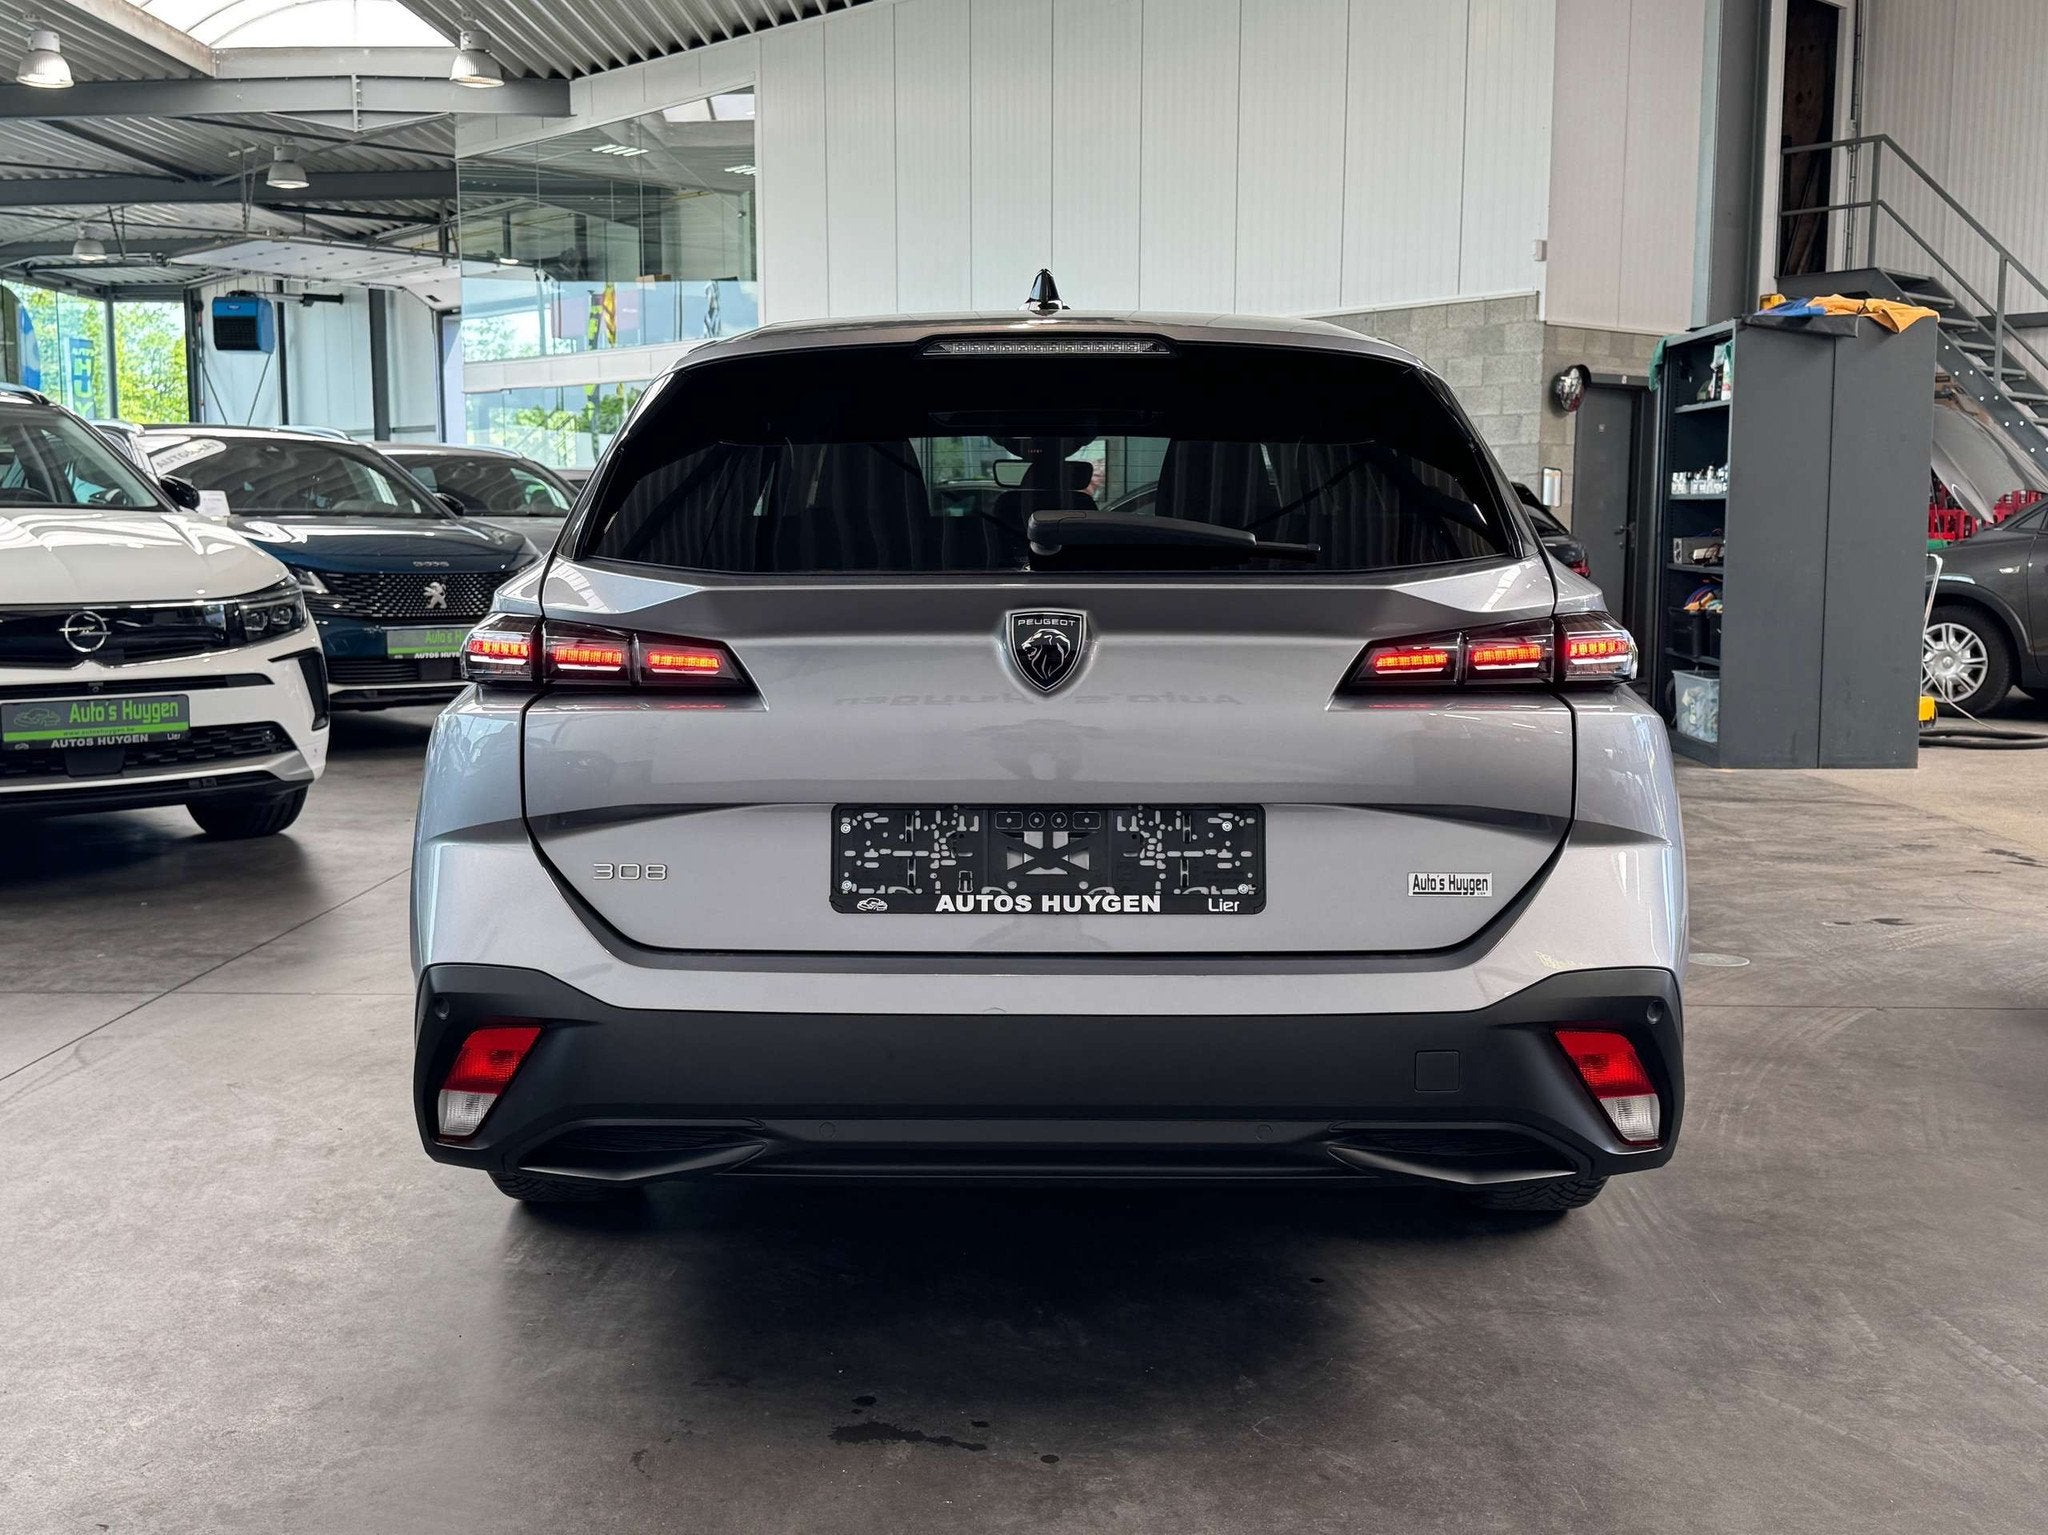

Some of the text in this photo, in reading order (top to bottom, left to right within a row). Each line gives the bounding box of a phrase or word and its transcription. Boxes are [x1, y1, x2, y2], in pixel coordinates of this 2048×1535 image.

[1018, 618, 1076, 626] PEUGEOT
[69, 700, 179, 723] Auto's Huygen
[51, 734, 148, 748] AUTOS HUYGEN
[592, 863, 667, 880] 308
[1413, 874, 1488, 895] Auto's Huygen
[935, 894, 1161, 912] AUTOS HUYGEN
[1208, 898, 1239, 912] Lier
